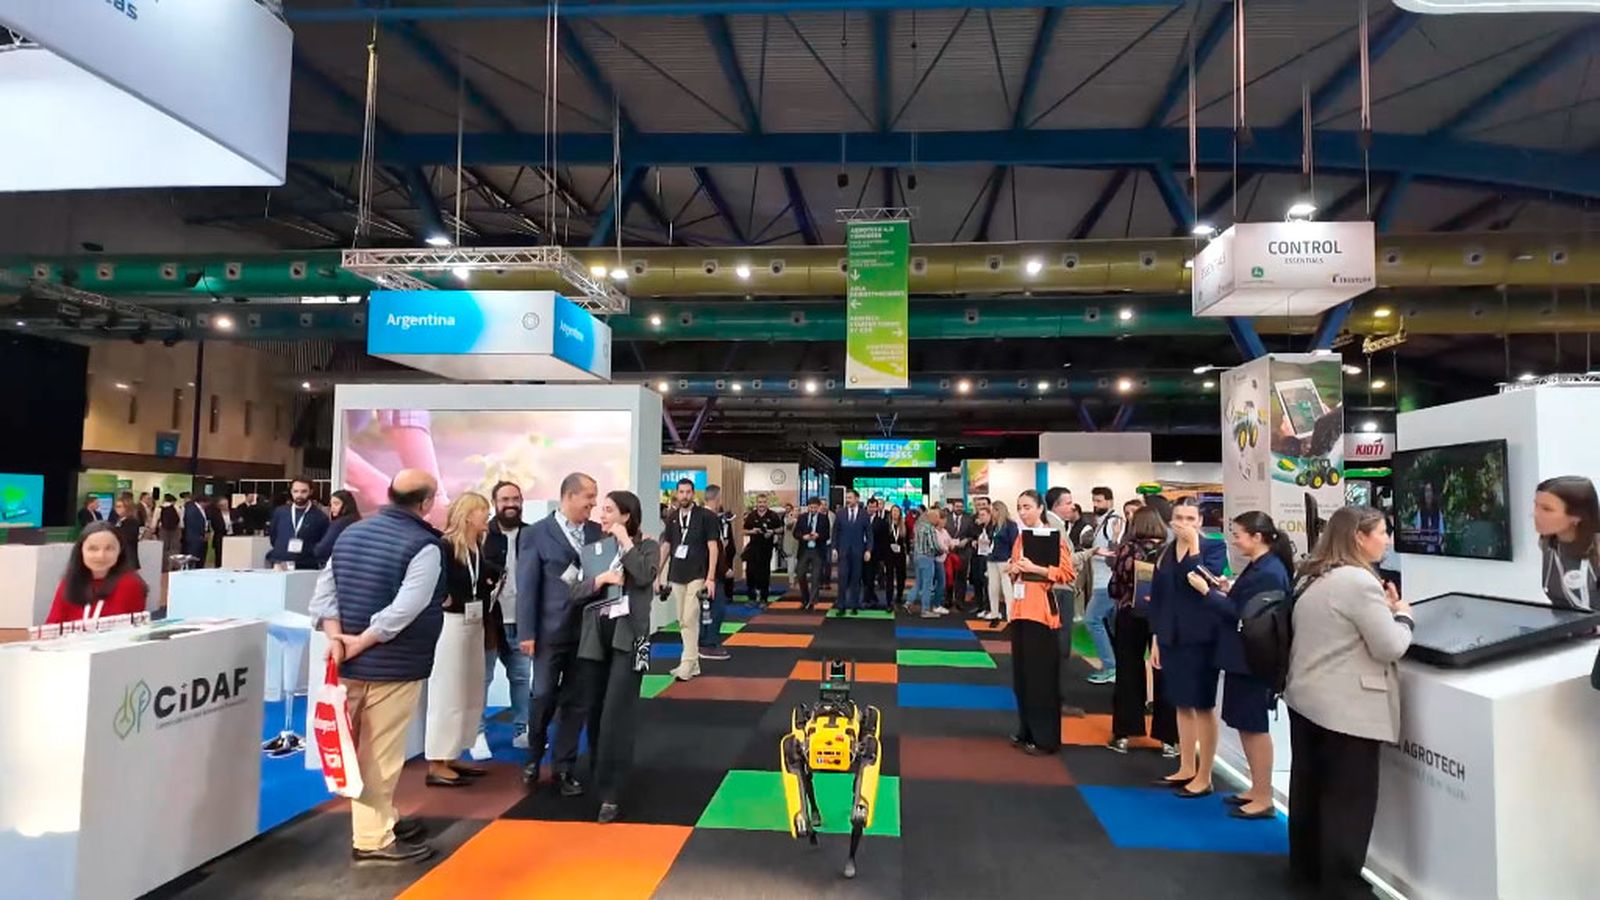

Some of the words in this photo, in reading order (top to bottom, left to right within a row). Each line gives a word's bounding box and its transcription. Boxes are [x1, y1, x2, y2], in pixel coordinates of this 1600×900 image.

[1268, 239, 1344, 255] CONTROL
[386, 312, 456, 330] Argentina
[864, 450, 913, 459] CONGRESS
[1355, 443, 1384, 456] KIOTI
[661, 470, 696, 483] ntina
[153, 667, 249, 719] CiDAF
[1402, 739, 1465, 781] AGROTECH
